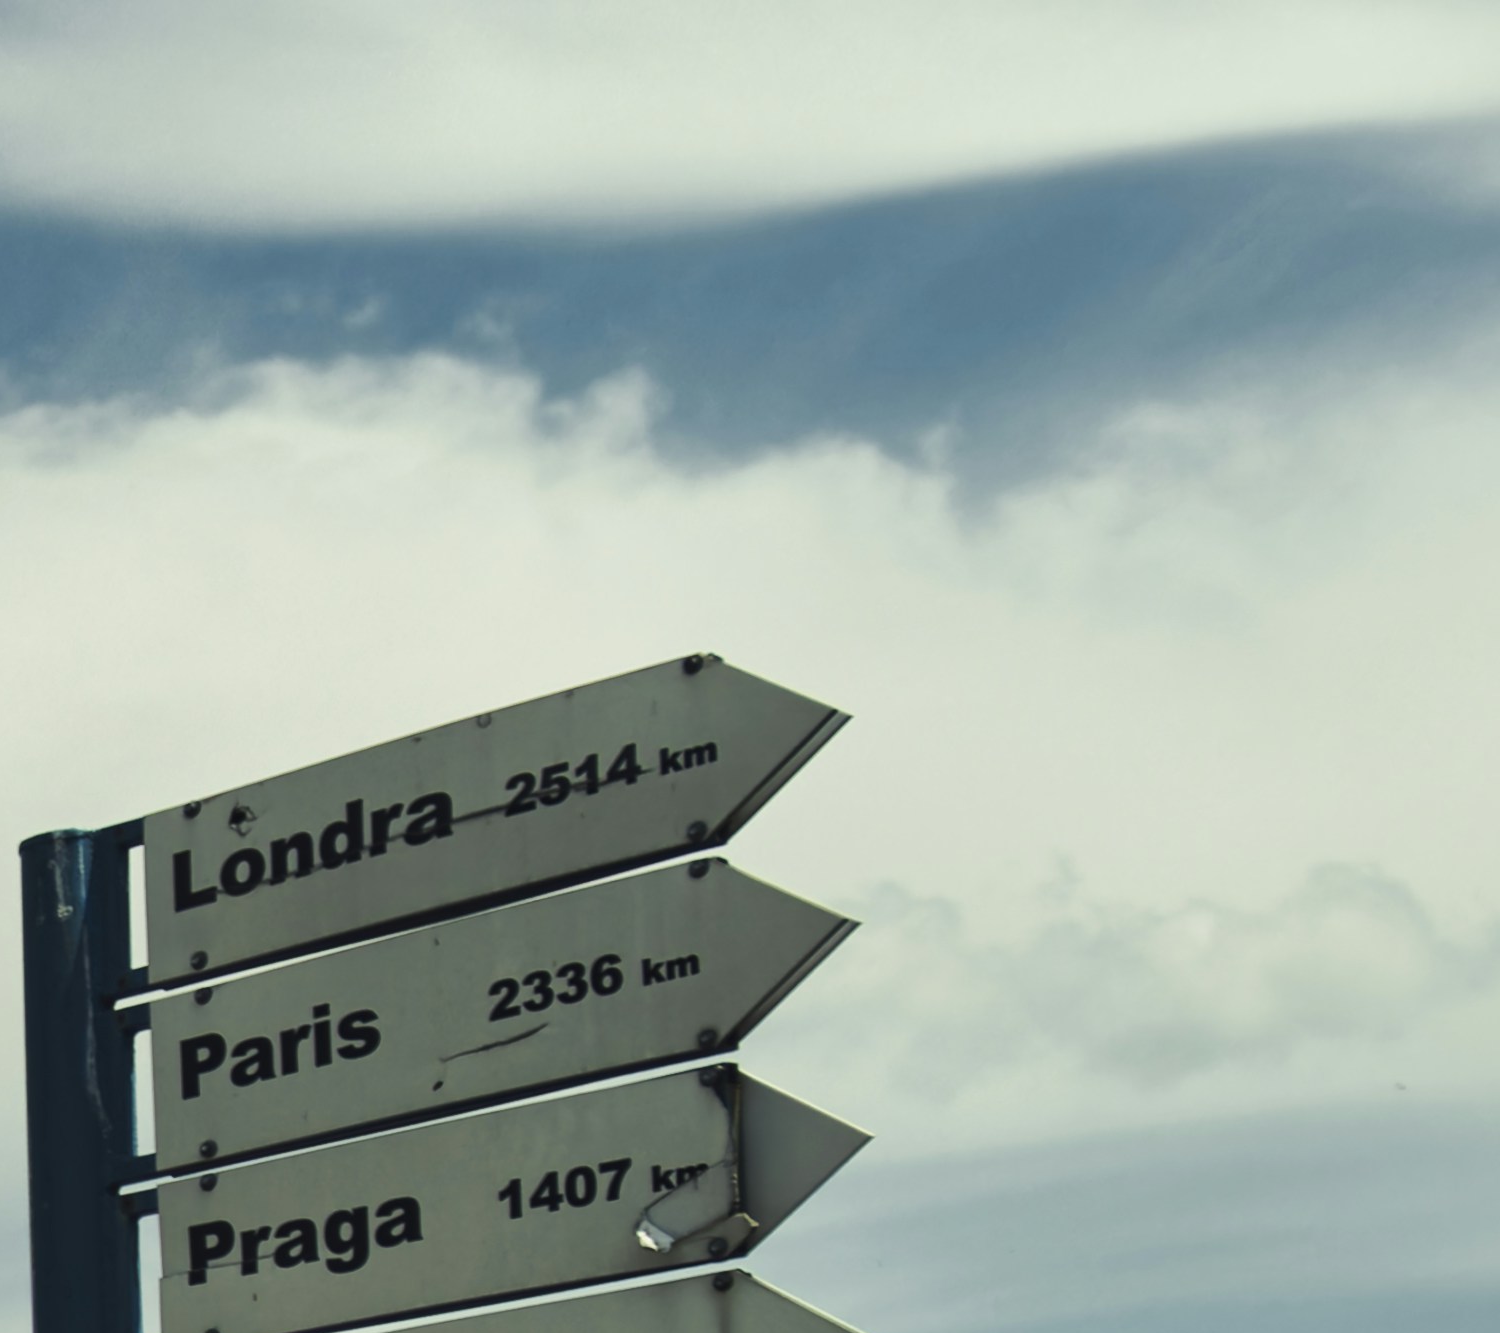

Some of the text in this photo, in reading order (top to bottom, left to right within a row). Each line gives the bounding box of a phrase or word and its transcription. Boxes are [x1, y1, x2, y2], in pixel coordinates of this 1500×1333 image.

[171, 736, 719, 913] Londra 2514 km
[177, 949, 701, 1099] Paris 2336 km
[186, 1194, 423, 1286] Praga
[498, 1158, 632, 1219] 1407
